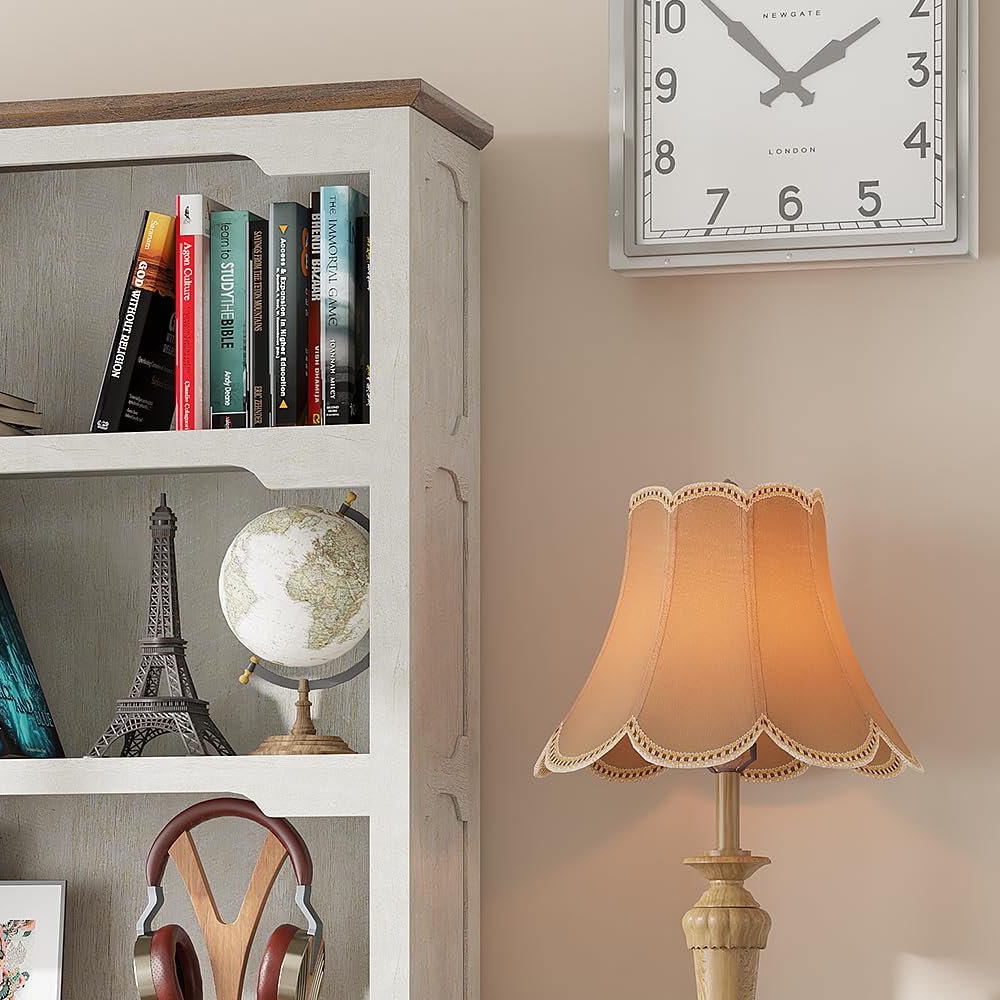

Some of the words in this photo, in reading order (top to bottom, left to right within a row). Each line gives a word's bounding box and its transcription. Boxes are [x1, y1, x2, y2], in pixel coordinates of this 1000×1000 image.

[655, 0, 686, 34] 10
[762, 9, 823, 19] NEWGATE
[654, 67, 678, 103] 9
[906, 51, 931, 88] 3
[768, 146, 817, 156] LONDON
[902, 121, 932, 159] 4
[654, 139, 676, 176] 8
[329, 195, 337, 215] THE
[706, 187, 731, 226] 7
[778, 185, 803, 221] 6
[857, 180, 882, 218] 5
[144, 219, 159, 251] Saranam
[220, 223, 232, 247] learn
[253, 230, 263, 254] SAYINGS
[311, 213, 320, 255] BHENDI
[182, 242, 193, 267] Agon
[220, 249, 231, 259] to
[253, 254, 262, 270] FROM
[326, 219, 338, 284] IMMORTAL
[135, 260, 149, 287] GOD
[183, 268, 193, 301] Culture
[253, 270, 262, 281] THE
[311, 258, 320, 301] BAZAAR
[121, 290, 141, 334] WITHOUT
[278, 276, 287, 318] Expansion
[328, 287, 338, 327] GAME
[253, 299, 262, 332] MOUNTAINS
[280, 318, 287, 327] in
[111, 334, 130, 379] RELIGION
[278, 328, 287, 356] Higher
[223, 370, 233, 387] Andy
[223, 387, 232, 407] Deane
